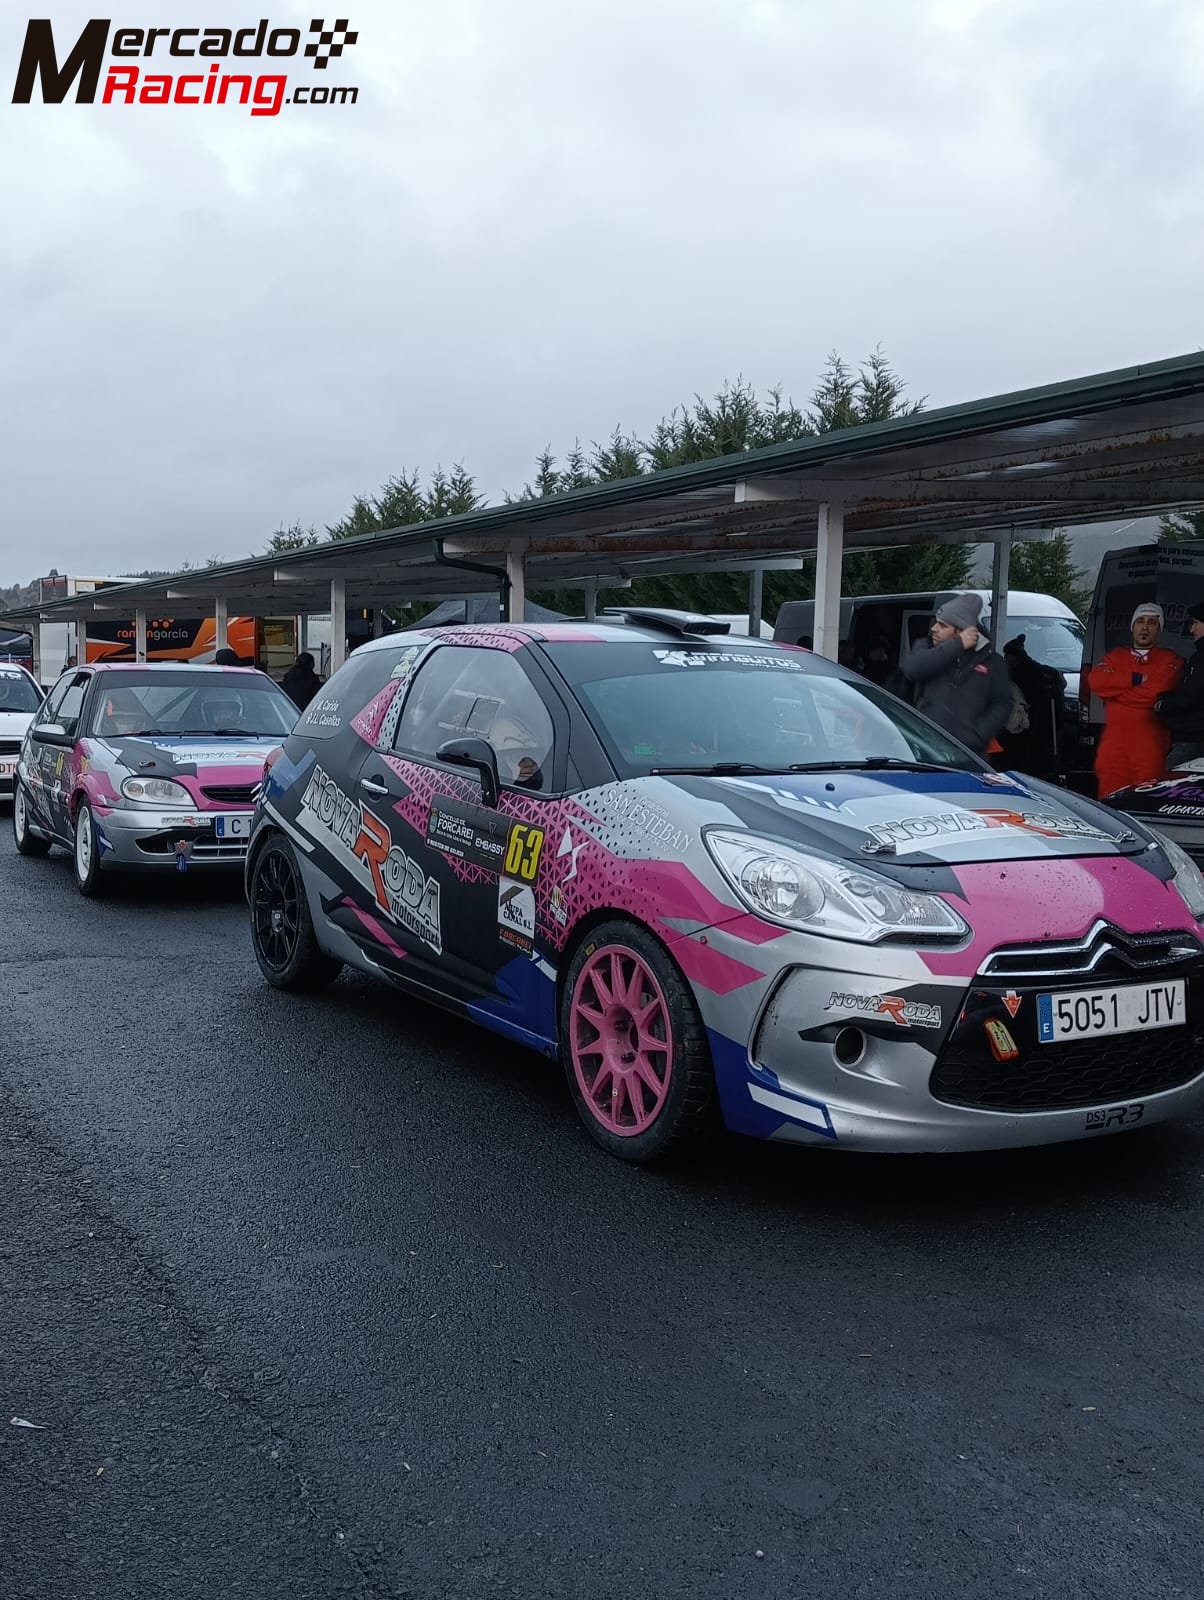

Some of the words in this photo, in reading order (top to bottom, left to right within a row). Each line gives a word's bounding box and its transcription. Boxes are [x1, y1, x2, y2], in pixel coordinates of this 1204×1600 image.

[231, 819, 241, 834] C
[437, 818, 474, 840] FORCAREI
[603, 789, 632, 815] SAN
[628, 804, 694, 853] ESTEBAN
[475, 837, 506, 856] EMBASSY
[505, 824, 544, 880] 63
[1043, 1023, 1051, 1033] E
[1058, 993, 1118, 1033] 5051
[1138, 986, 1176, 1024] JTV
[1086, 1110, 1106, 1123] DS3
